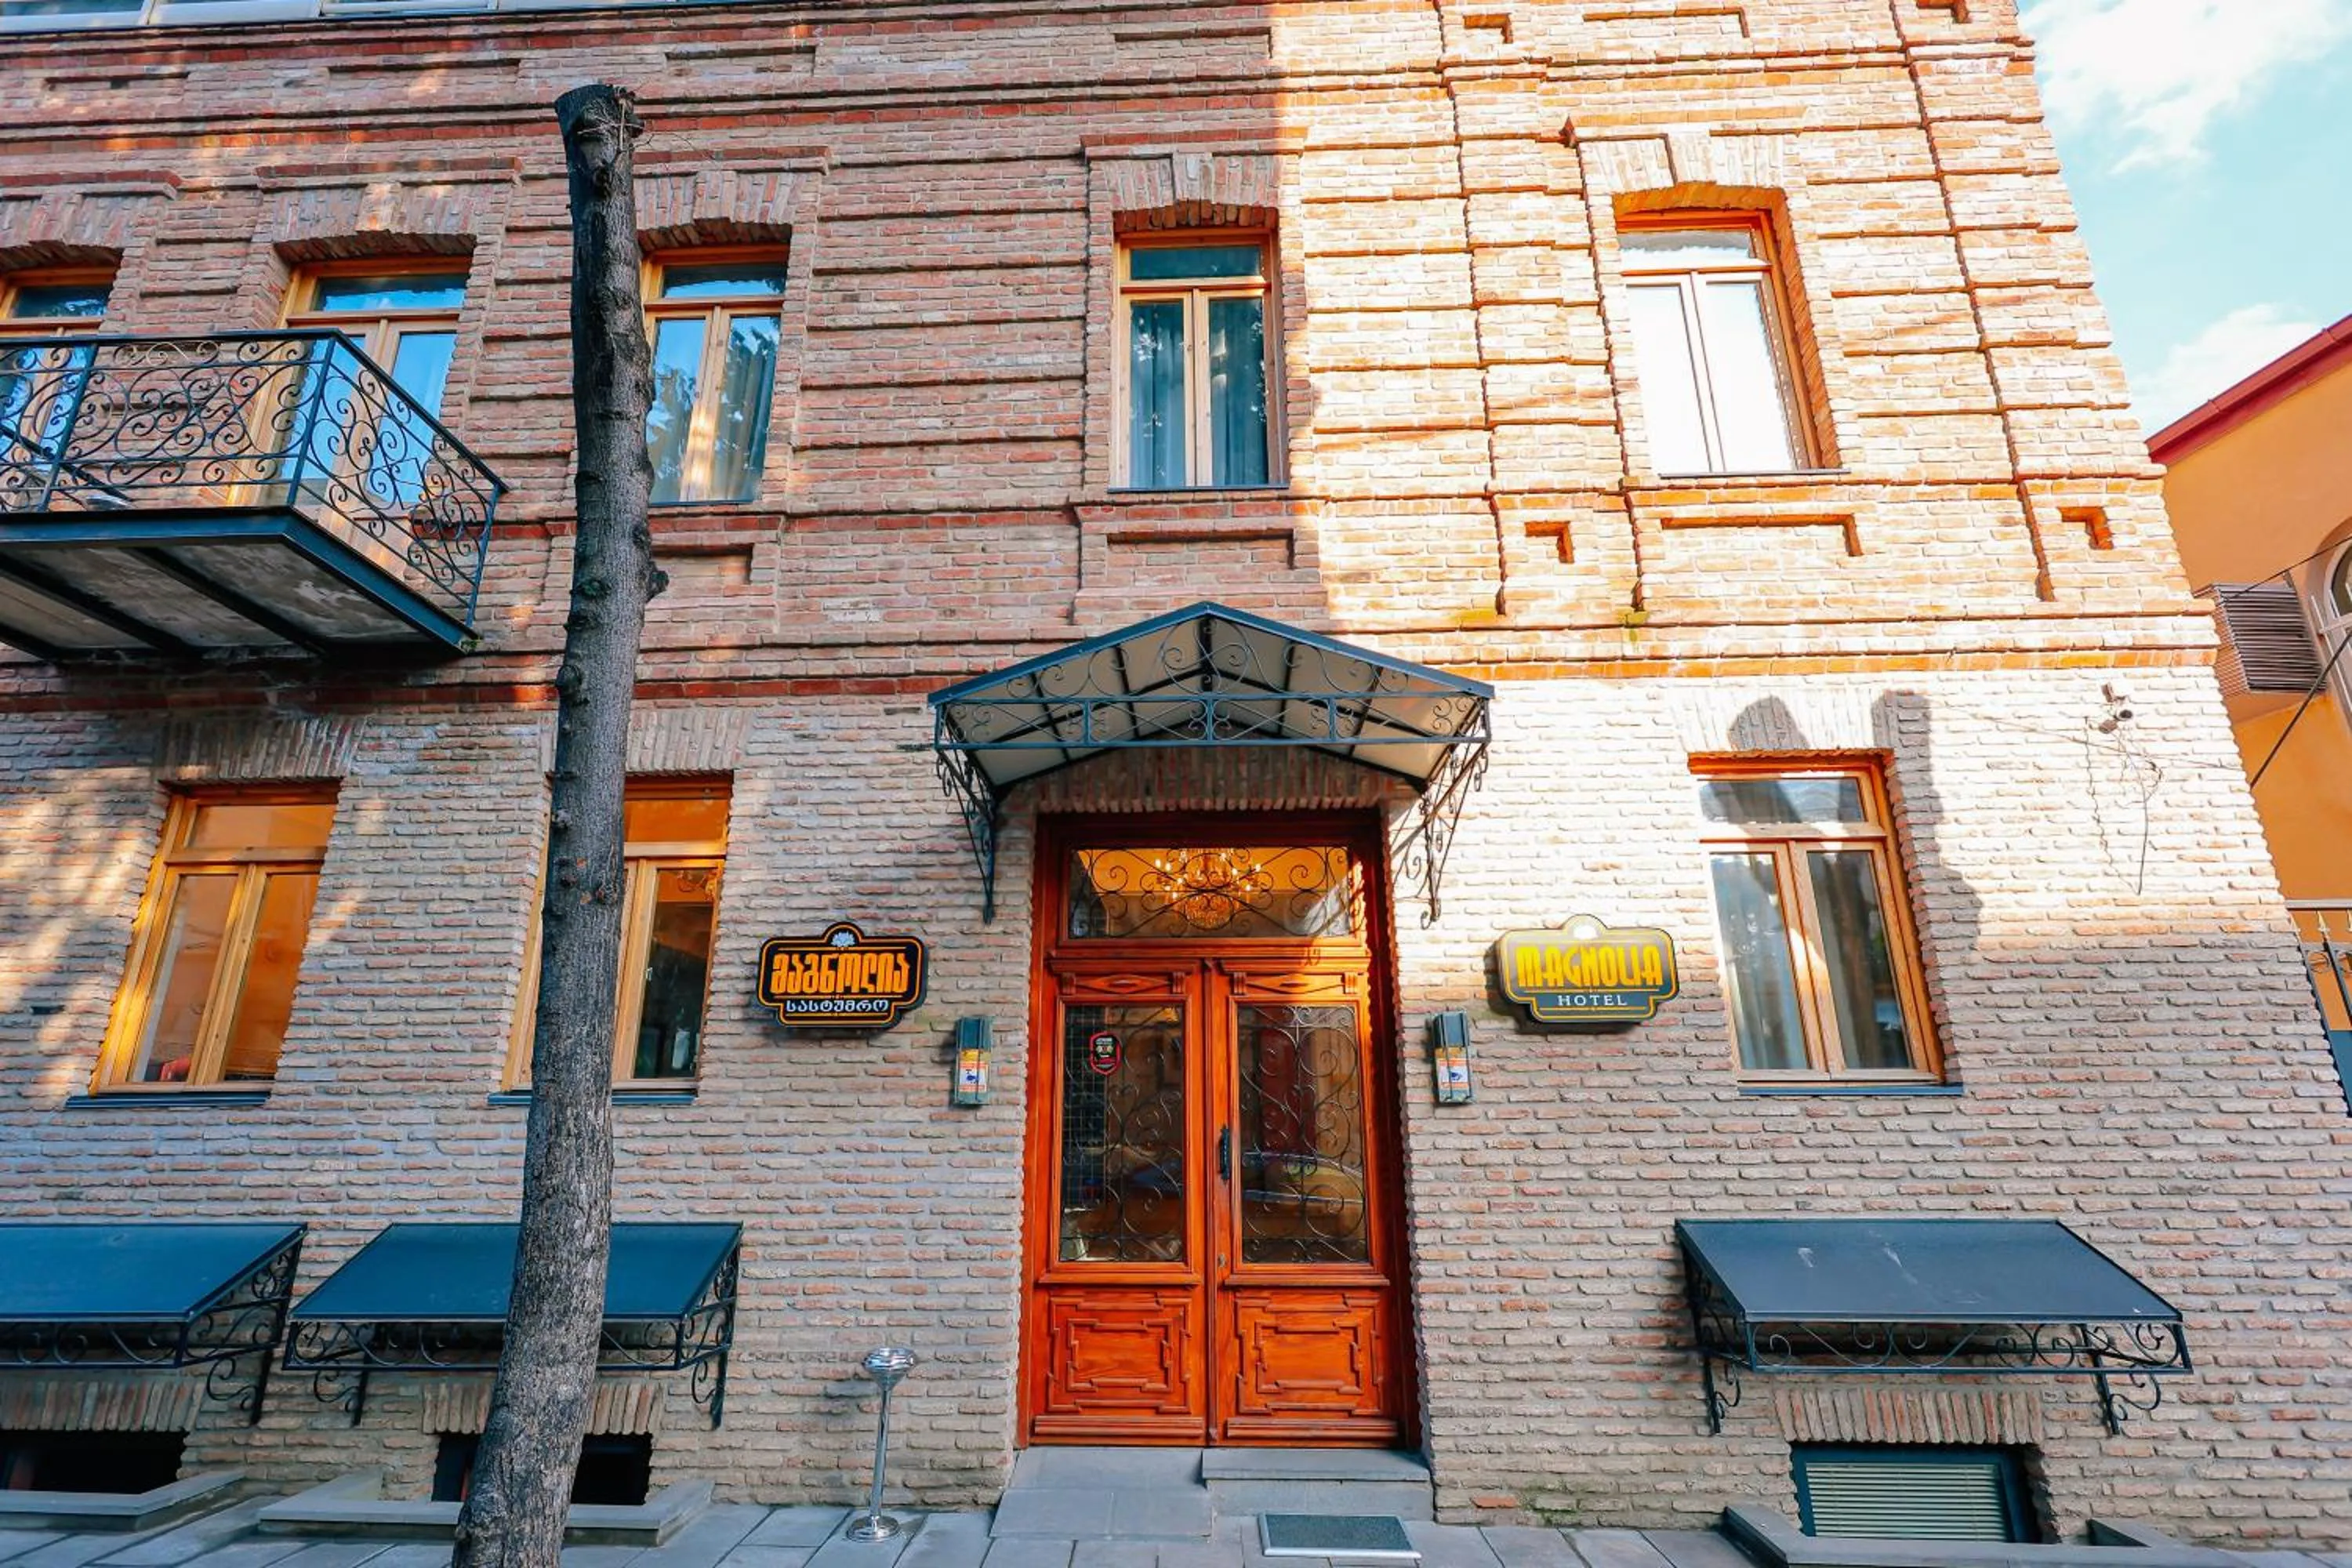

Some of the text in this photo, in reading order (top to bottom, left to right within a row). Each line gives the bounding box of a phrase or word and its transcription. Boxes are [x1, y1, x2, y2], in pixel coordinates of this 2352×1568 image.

[771, 953, 909, 993] მაგნოლია
[1516, 946, 1663, 987] MAGNOLIA
[786, 1000, 888, 1012] სასტუმრო
[1557, 995, 1628, 1006] HOTEL
